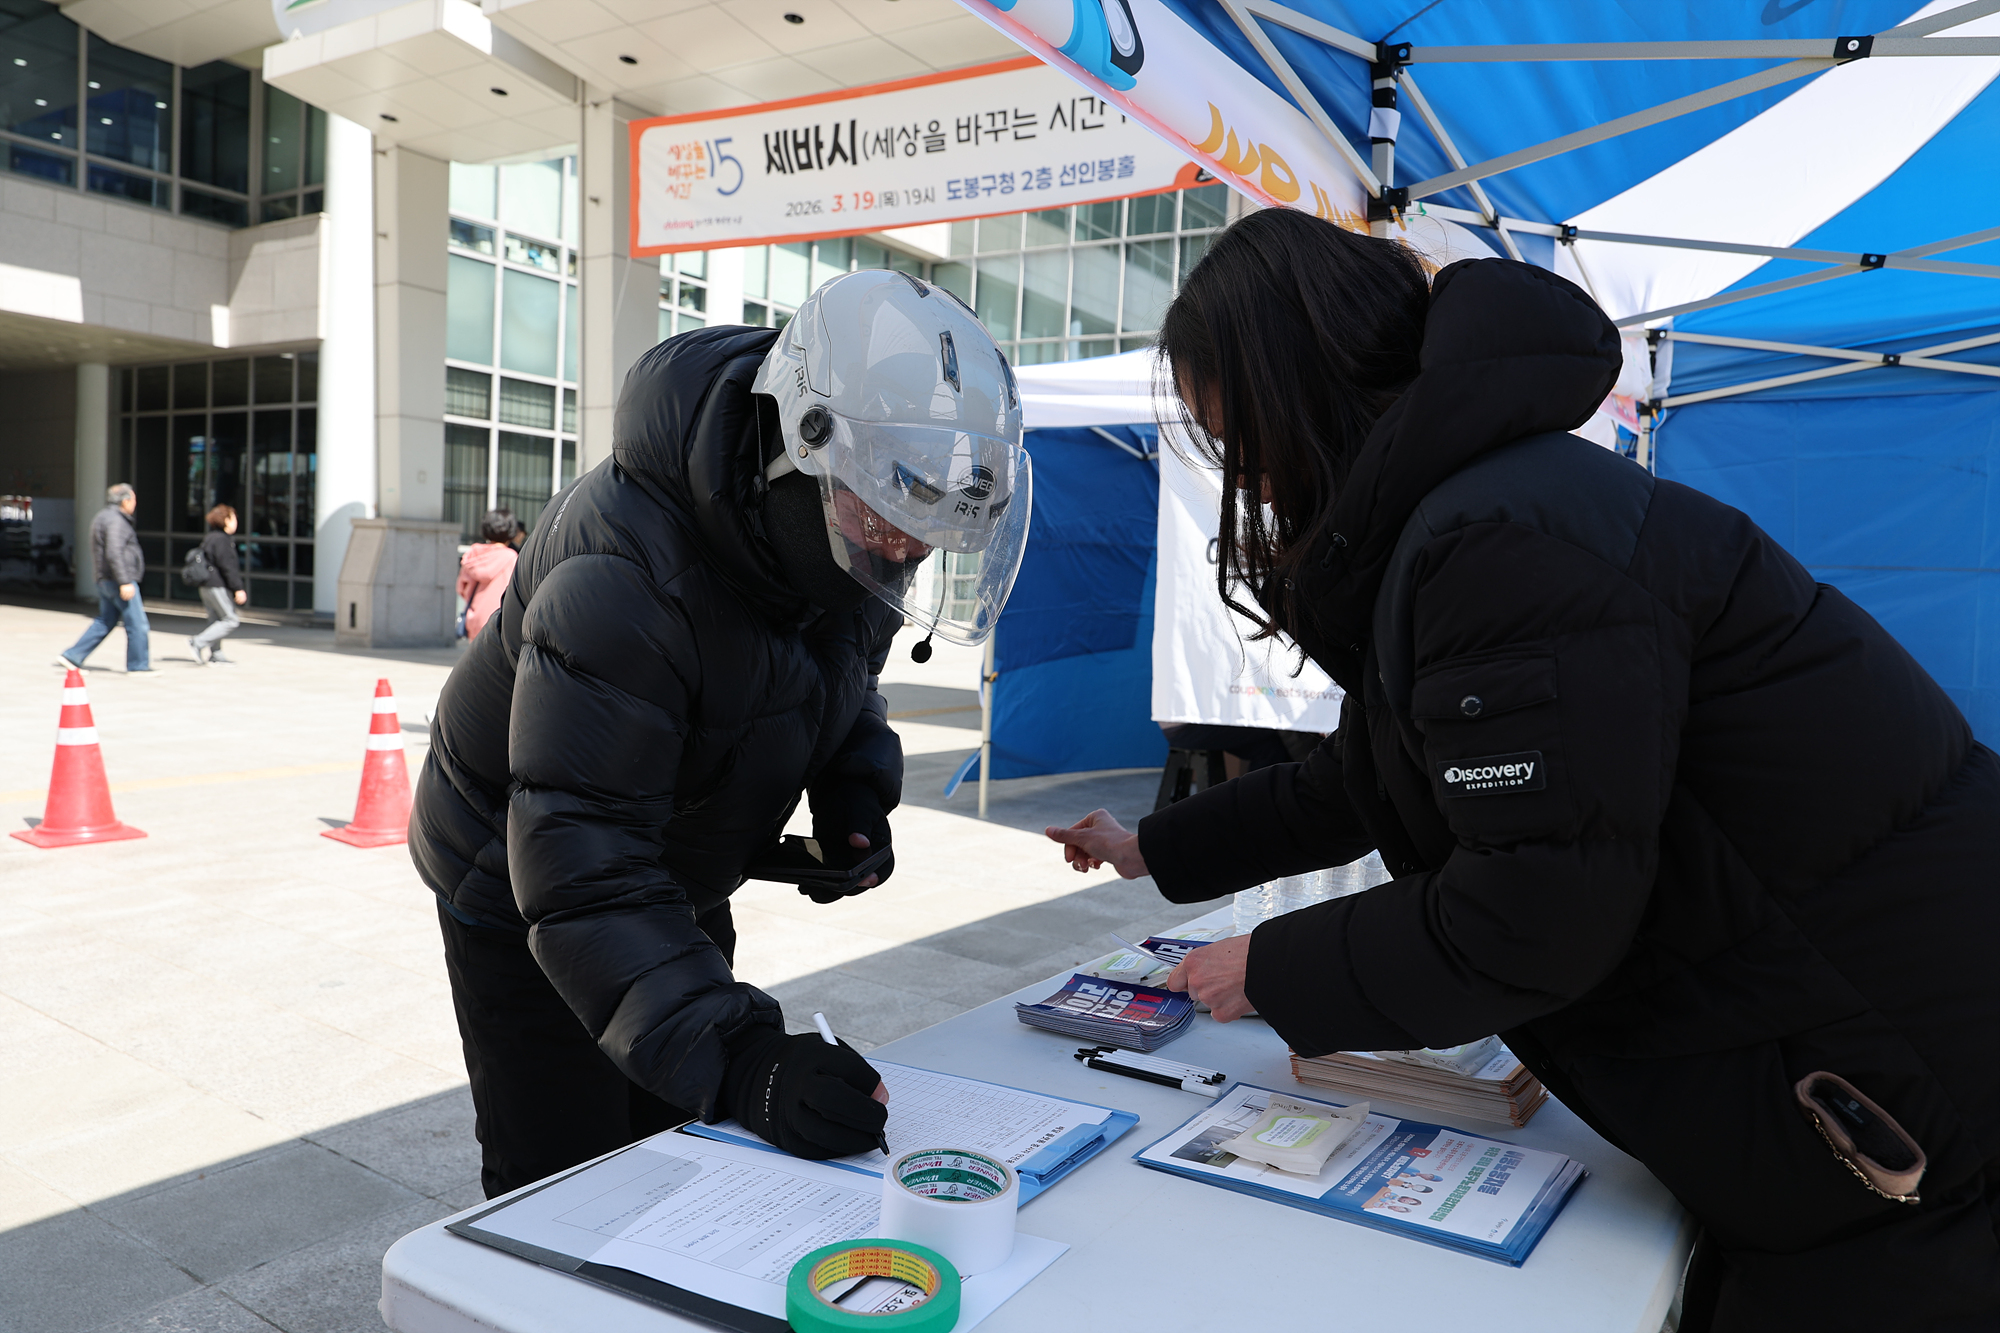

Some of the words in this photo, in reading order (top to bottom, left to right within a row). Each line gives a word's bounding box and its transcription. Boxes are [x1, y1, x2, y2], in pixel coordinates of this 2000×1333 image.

[956, 107, 1038, 146] 바꾸는
[1050, 96, 1107, 131] 시간
[785, 200, 824, 217] 2026.
[831, 194, 847, 212] 3.
[904, 187, 935, 205] 19시
[946, 171, 1015, 200] 도봉구청
[1021, 166, 1053, 191] 2층
[1059, 155, 1135, 187] 선인봉홀
[1445, 761, 1535, 784] Discovery
[1465, 777, 1524, 790] EXPEDITION
[906, 1160, 943, 1174] WINNER
[968, 1165, 999, 1183] WINNER
[905, 1174, 940, 1186] WINNER
[966, 1178, 998, 1196] WINNER
